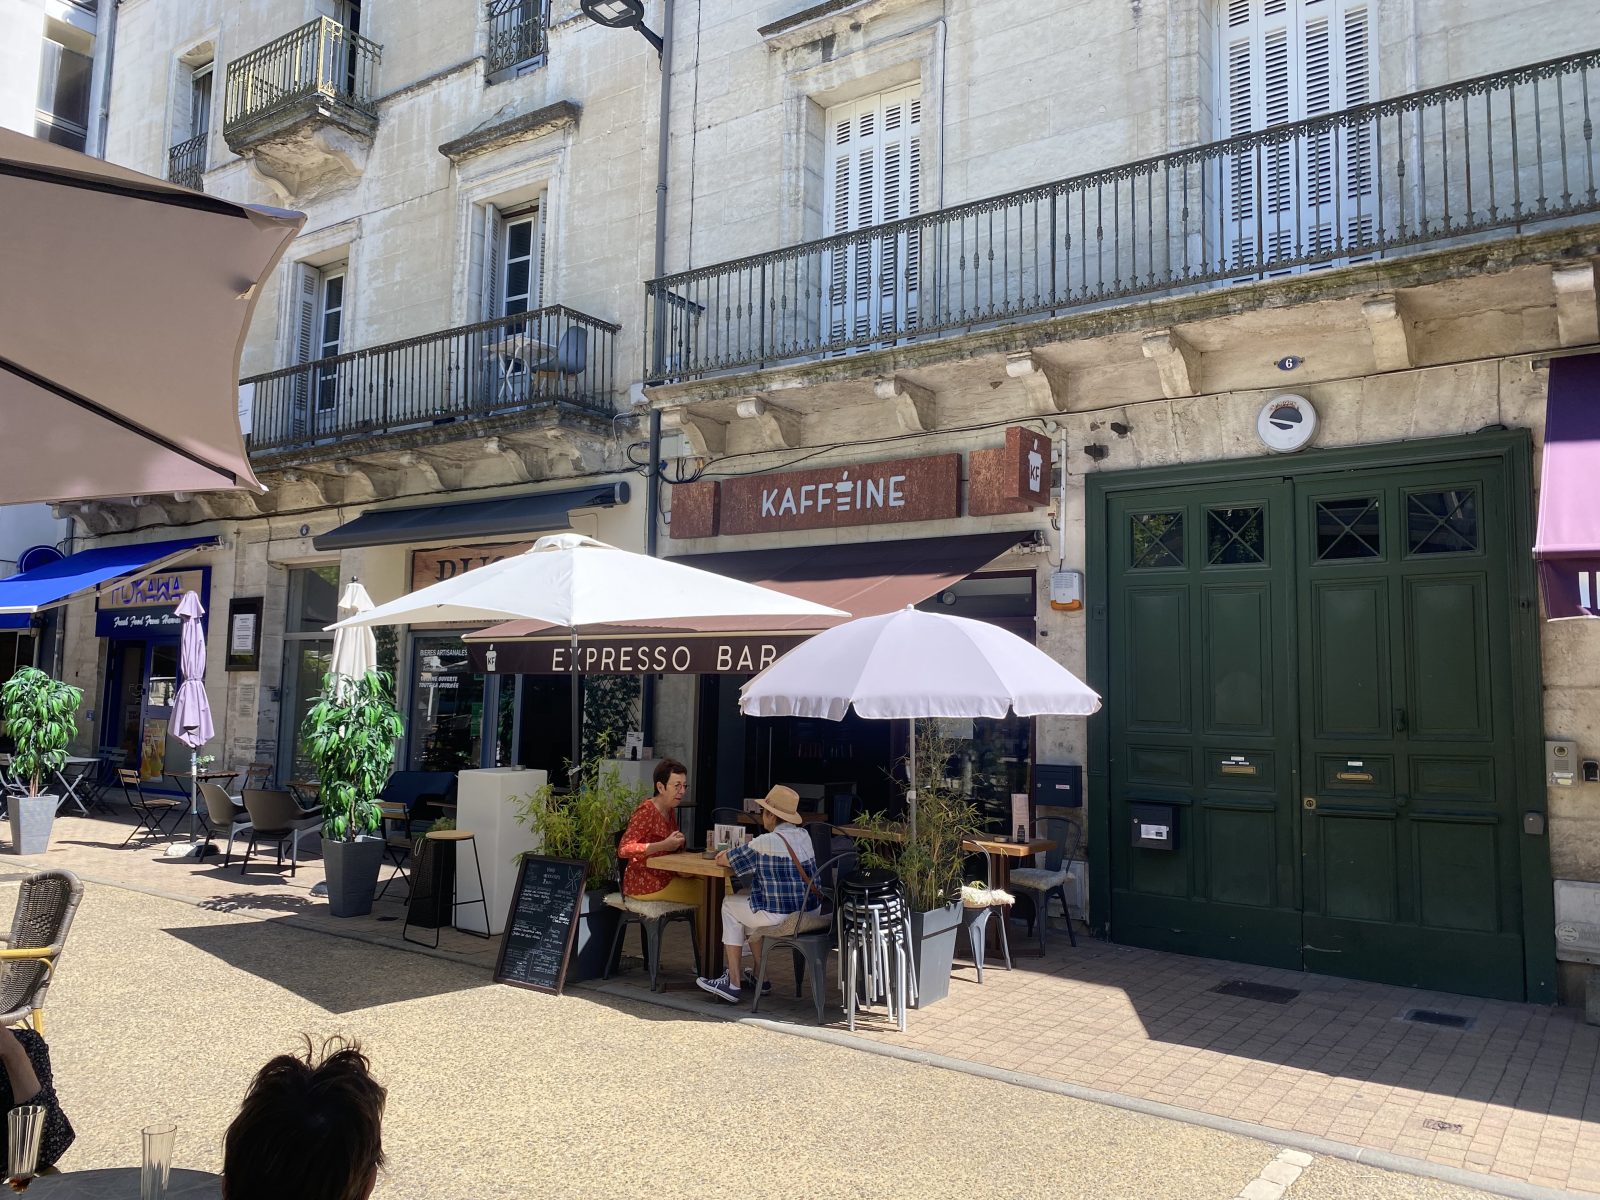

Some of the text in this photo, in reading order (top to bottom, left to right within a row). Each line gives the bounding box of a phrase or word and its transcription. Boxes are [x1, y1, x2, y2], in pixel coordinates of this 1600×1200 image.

[1285, 358, 1293, 369] 6
[1030, 464, 1040, 482] KF
[129, 615, 144, 628] Food
[145, 614, 160, 627] From
[437, 648, 468, 656] ARTISANALES
[487, 656, 496, 665] KF
[552, 644, 777, 673] EXPRESSO BAR
